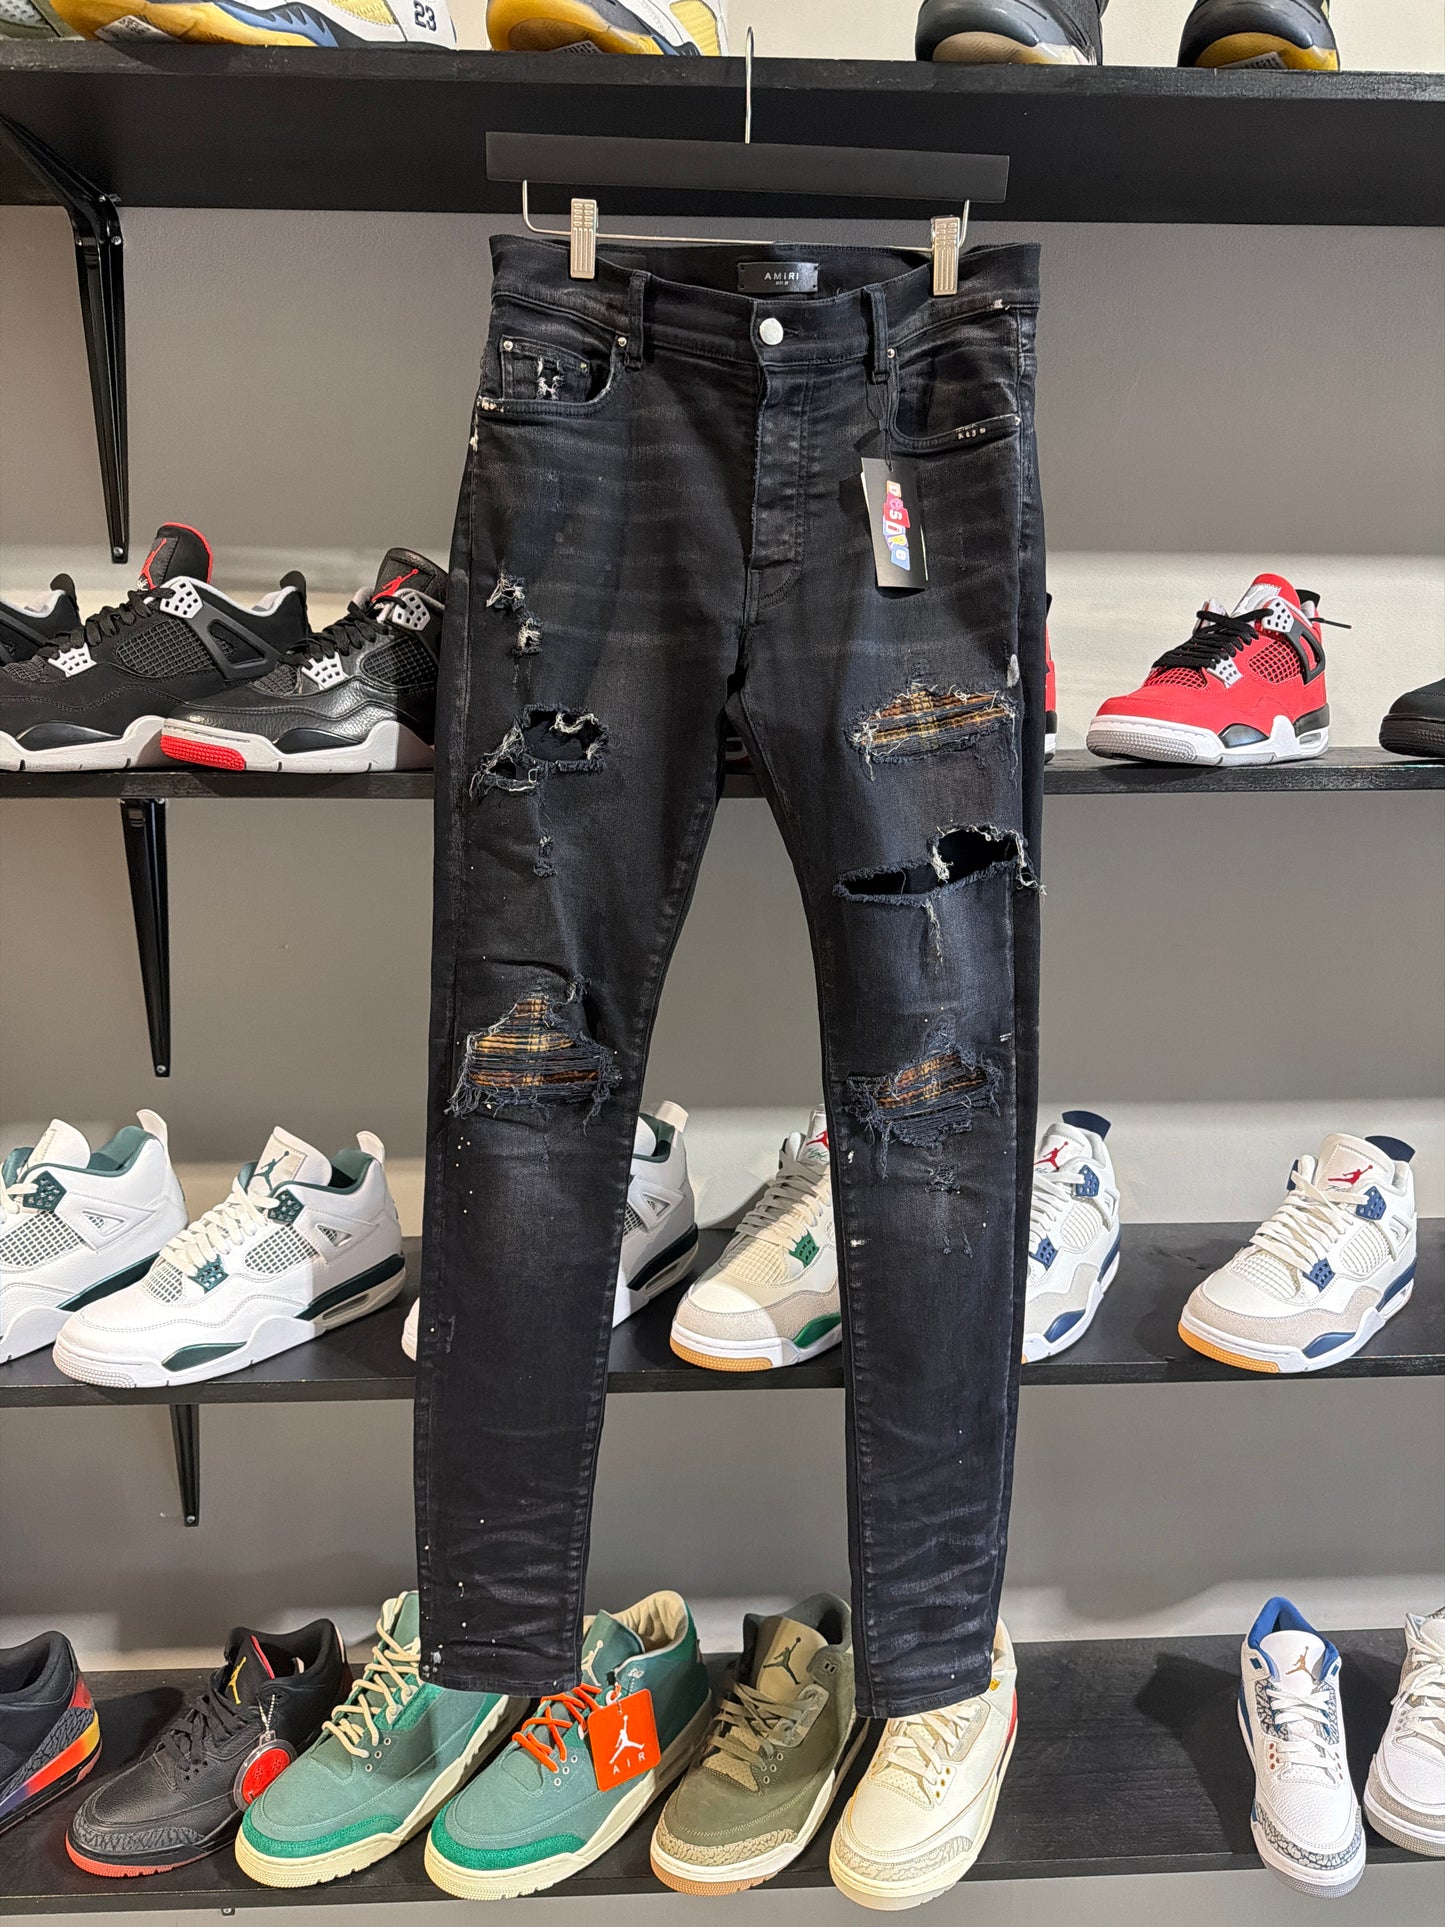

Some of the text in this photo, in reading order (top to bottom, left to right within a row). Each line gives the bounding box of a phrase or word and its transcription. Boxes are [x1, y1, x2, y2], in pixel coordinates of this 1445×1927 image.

[413, 0, 437, 32] 23
[763, 271, 799, 280] AMIRI
[612, 1751, 646, 1775] AIR
